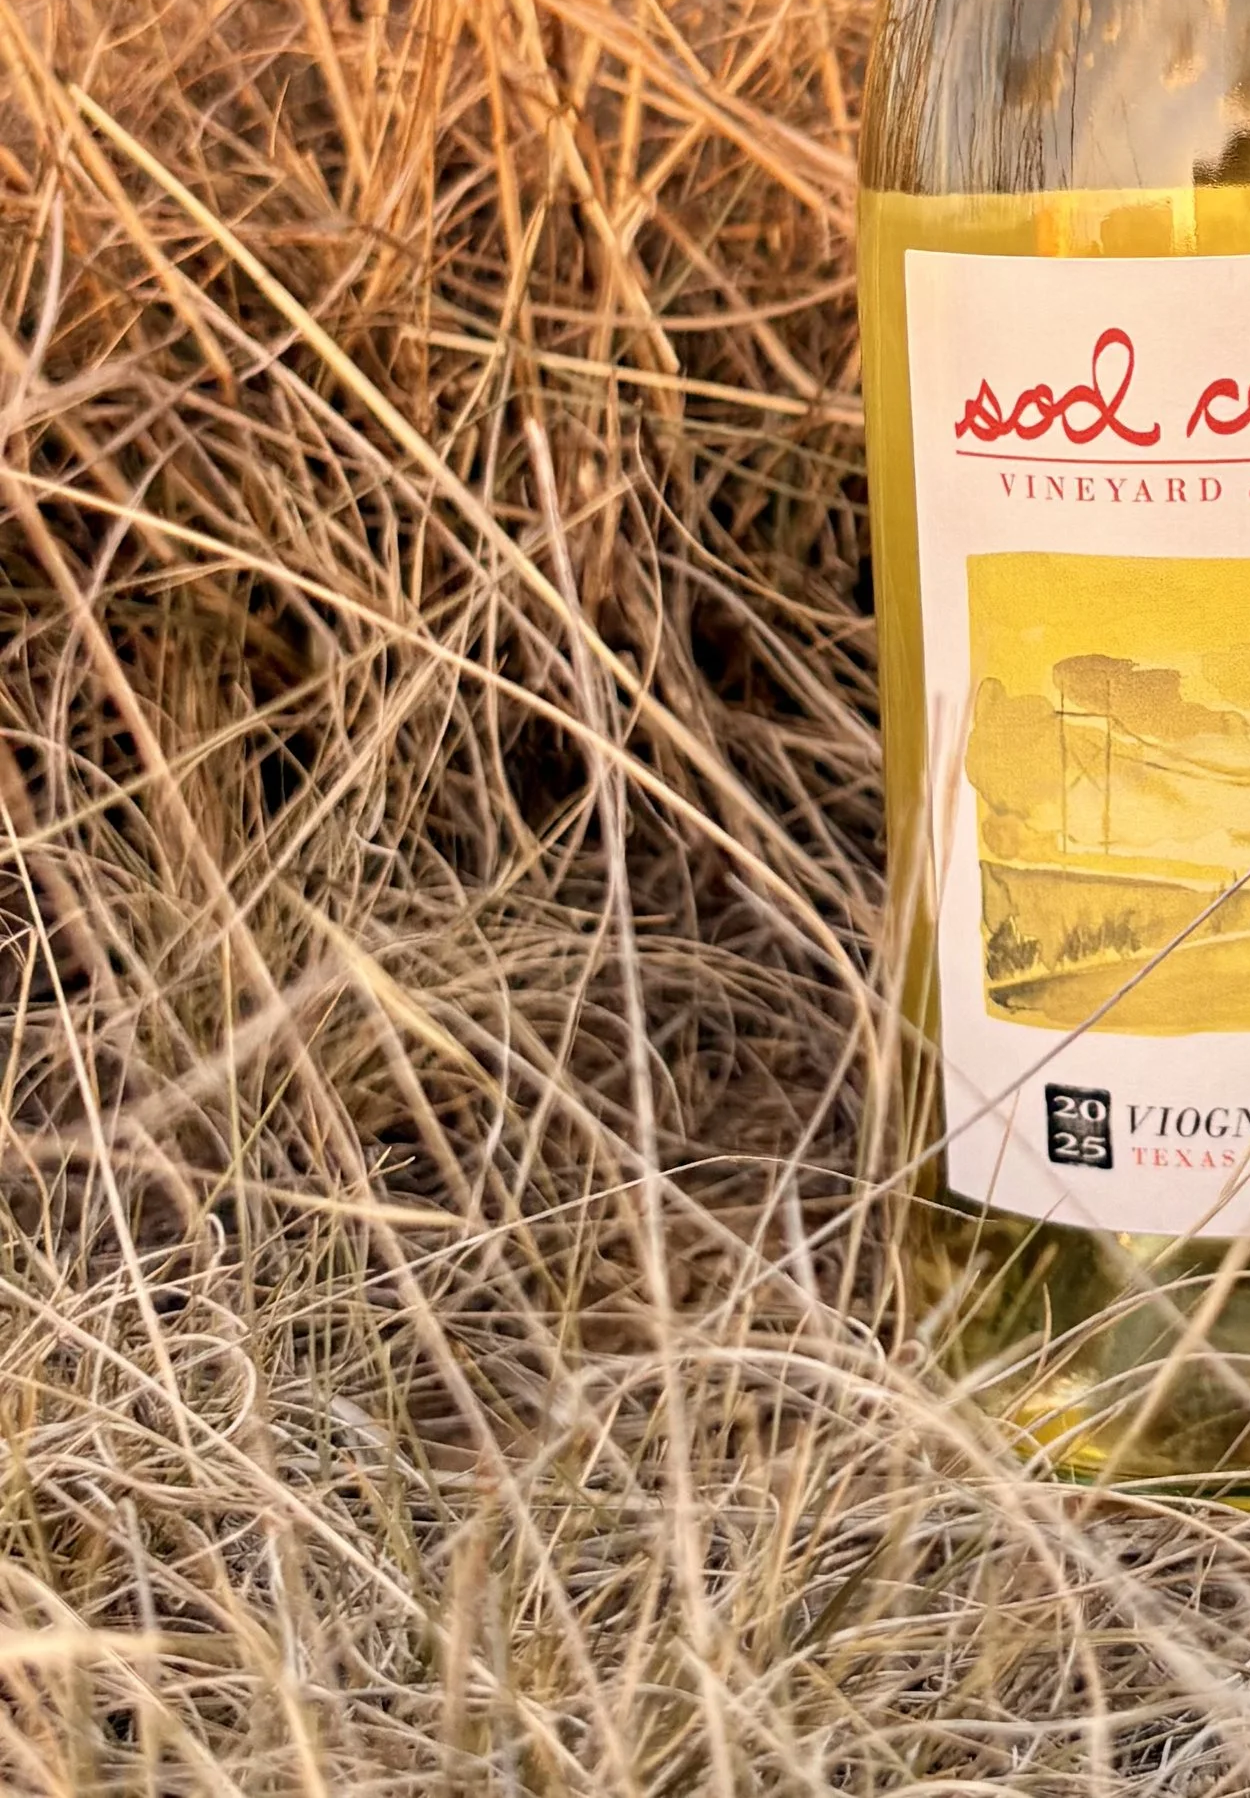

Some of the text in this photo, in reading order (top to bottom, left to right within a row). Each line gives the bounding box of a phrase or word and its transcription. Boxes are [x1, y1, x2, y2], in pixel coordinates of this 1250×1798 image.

[955, 327, 1161, 446] sod
[1000, 471, 1223, 502] VINEYARD
[1052, 1095, 1106, 1122] 20
[1053, 1131, 1106, 1159] 25
[1132, 1147, 1236, 1169] TEXAS
